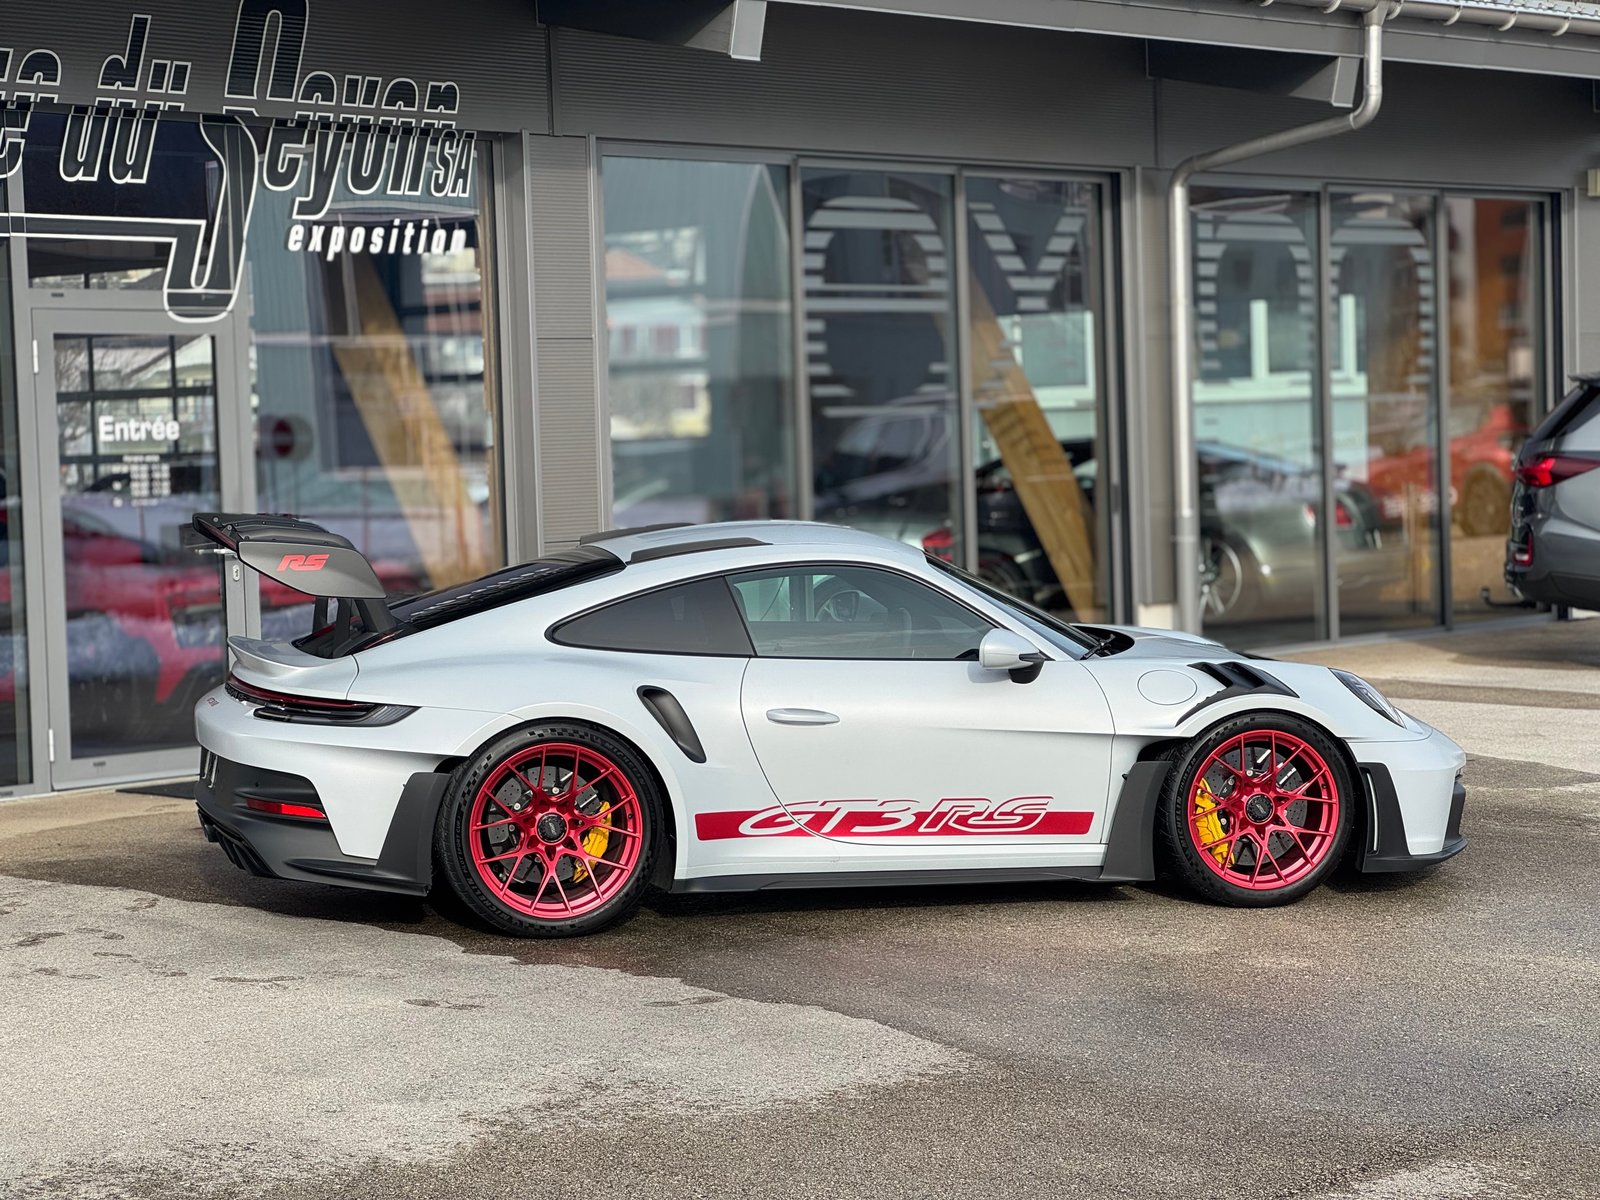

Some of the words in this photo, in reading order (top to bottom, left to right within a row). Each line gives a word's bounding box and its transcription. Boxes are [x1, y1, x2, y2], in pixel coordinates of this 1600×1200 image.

[59, 14, 192, 183] du
[431, 130, 477, 197] SA
[288, 218, 467, 262] exposition
[98, 415, 180, 442] Entrée
[276, 553, 330, 572] RS
[738, 798, 920, 836] GT3
[917, 795, 1054, 834] RS
[465, 874, 510, 922] MICHELIN
